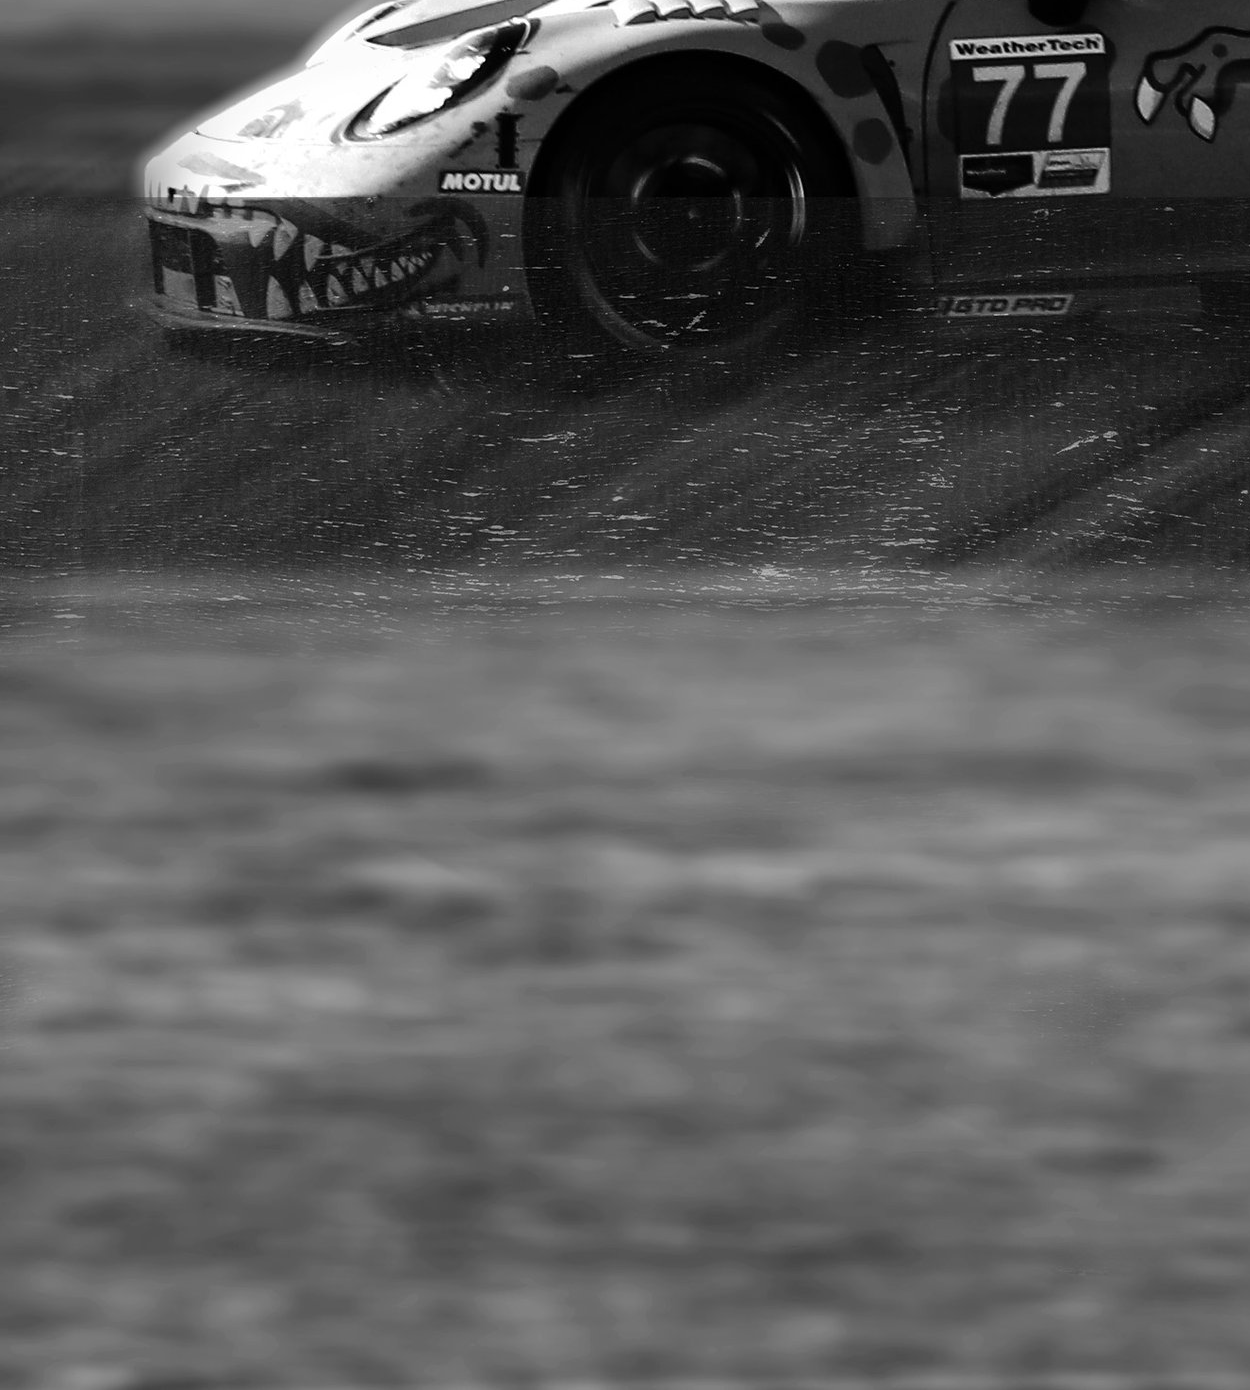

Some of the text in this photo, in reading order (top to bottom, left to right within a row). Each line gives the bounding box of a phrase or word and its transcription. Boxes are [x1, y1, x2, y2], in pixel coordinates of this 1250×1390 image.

[955, 38, 1100, 56] WeatherTech
[973, 62, 1087, 145] 77
[441, 172, 521, 192] MOTUL
[954, 297, 1067, 313] GTD PRO
